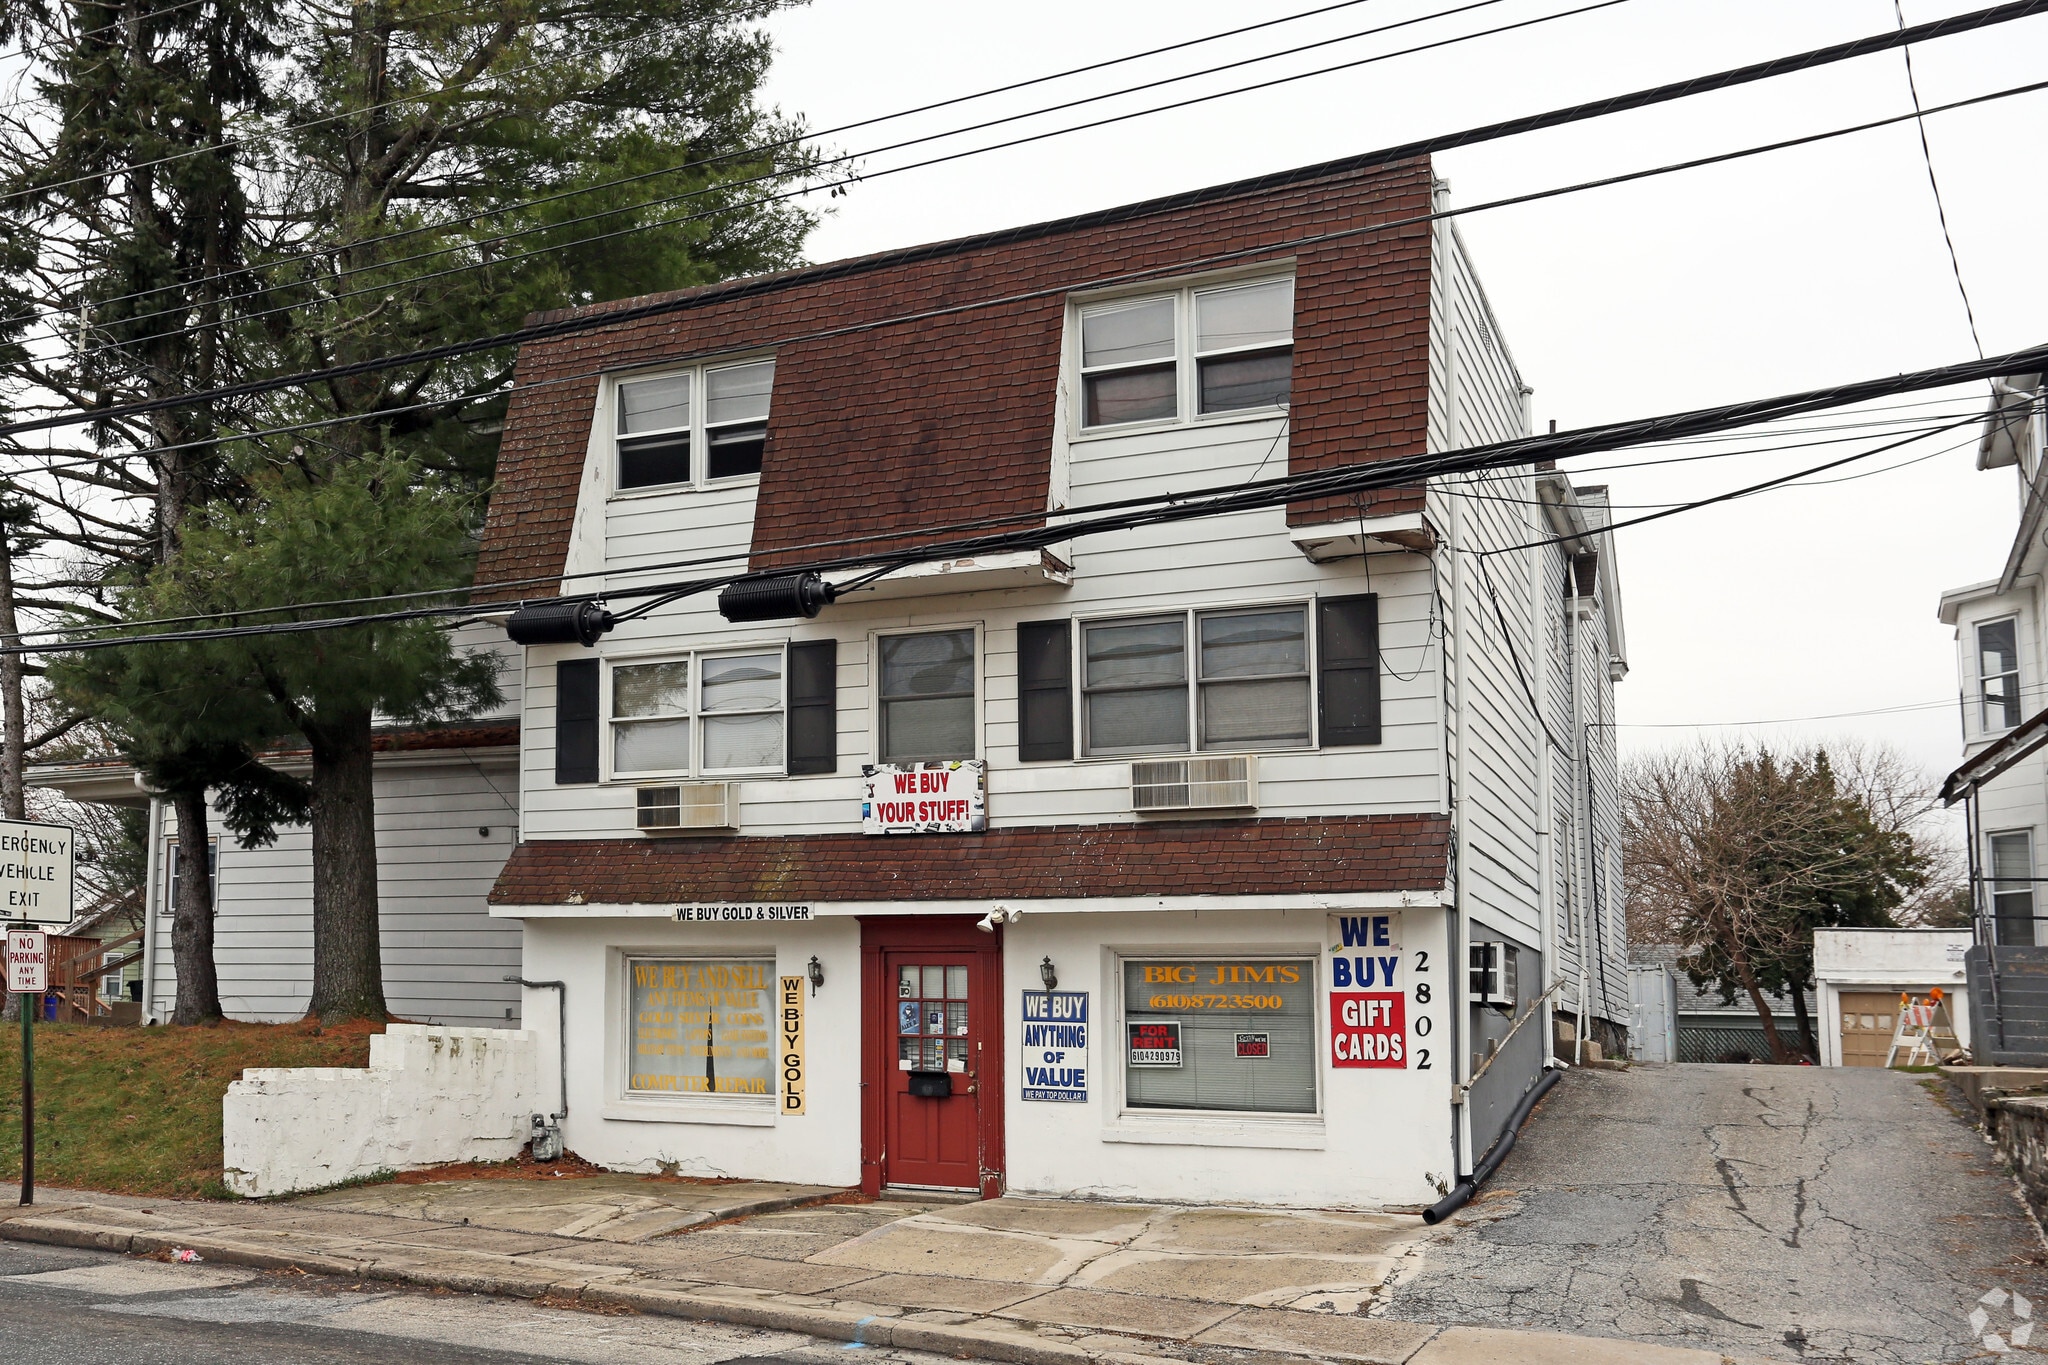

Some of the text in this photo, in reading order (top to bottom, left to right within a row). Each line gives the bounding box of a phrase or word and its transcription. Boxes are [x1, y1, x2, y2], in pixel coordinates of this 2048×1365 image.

[894, 772, 949, 794] WE BUY
[877, 800, 970, 823] YOUR STUFF!
[1, 836, 66, 855] ERGENCY
[9, 890, 40, 907] EXIT
[676, 906, 809, 920] WE BUY GOLD & SILVER
[1340, 916, 1390, 947] WE
[19, 938, 34, 949] NO
[9, 952, 44, 964] PARKING
[19, 966, 35, 975] ANY
[634, 966, 768, 990] WE BUY AND SELL
[1143, 965, 1300, 985] BIG JIM'S
[1332, 956, 1399, 988] BUY
[17, 976, 37, 986] TIME
[647, 991, 669, 1007] ANY
[671, 991, 706, 1007] ITEMS
[724, 991, 760, 1008] VALUE
[1026, 996, 1084, 1019] WE BUY
[639, 1011, 765, 1026] GOLD SILVER COINS
[1341, 999, 1393, 1028] GIFT
[1025, 1024, 1086, 1048] ANYTHING
[1139, 1025, 1167, 1036] FOR
[1132, 1037, 1176, 1048] RENT
[1237, 1043, 1267, 1055] CLOSED
[1334, 1032, 1404, 1062] CARDS
[1043, 1051, 1065, 1064] OF
[1132, 1051, 1180, 1061] 6104290979
[632, 1074, 767, 1093] COMPUTER REPAIR
[1026, 1067, 1085, 1087] VALUE
[1025, 1090, 1034, 1099] WE
[1035, 1090, 1046, 1099] PAY
[1046, 1091, 1057, 1099] TOP
